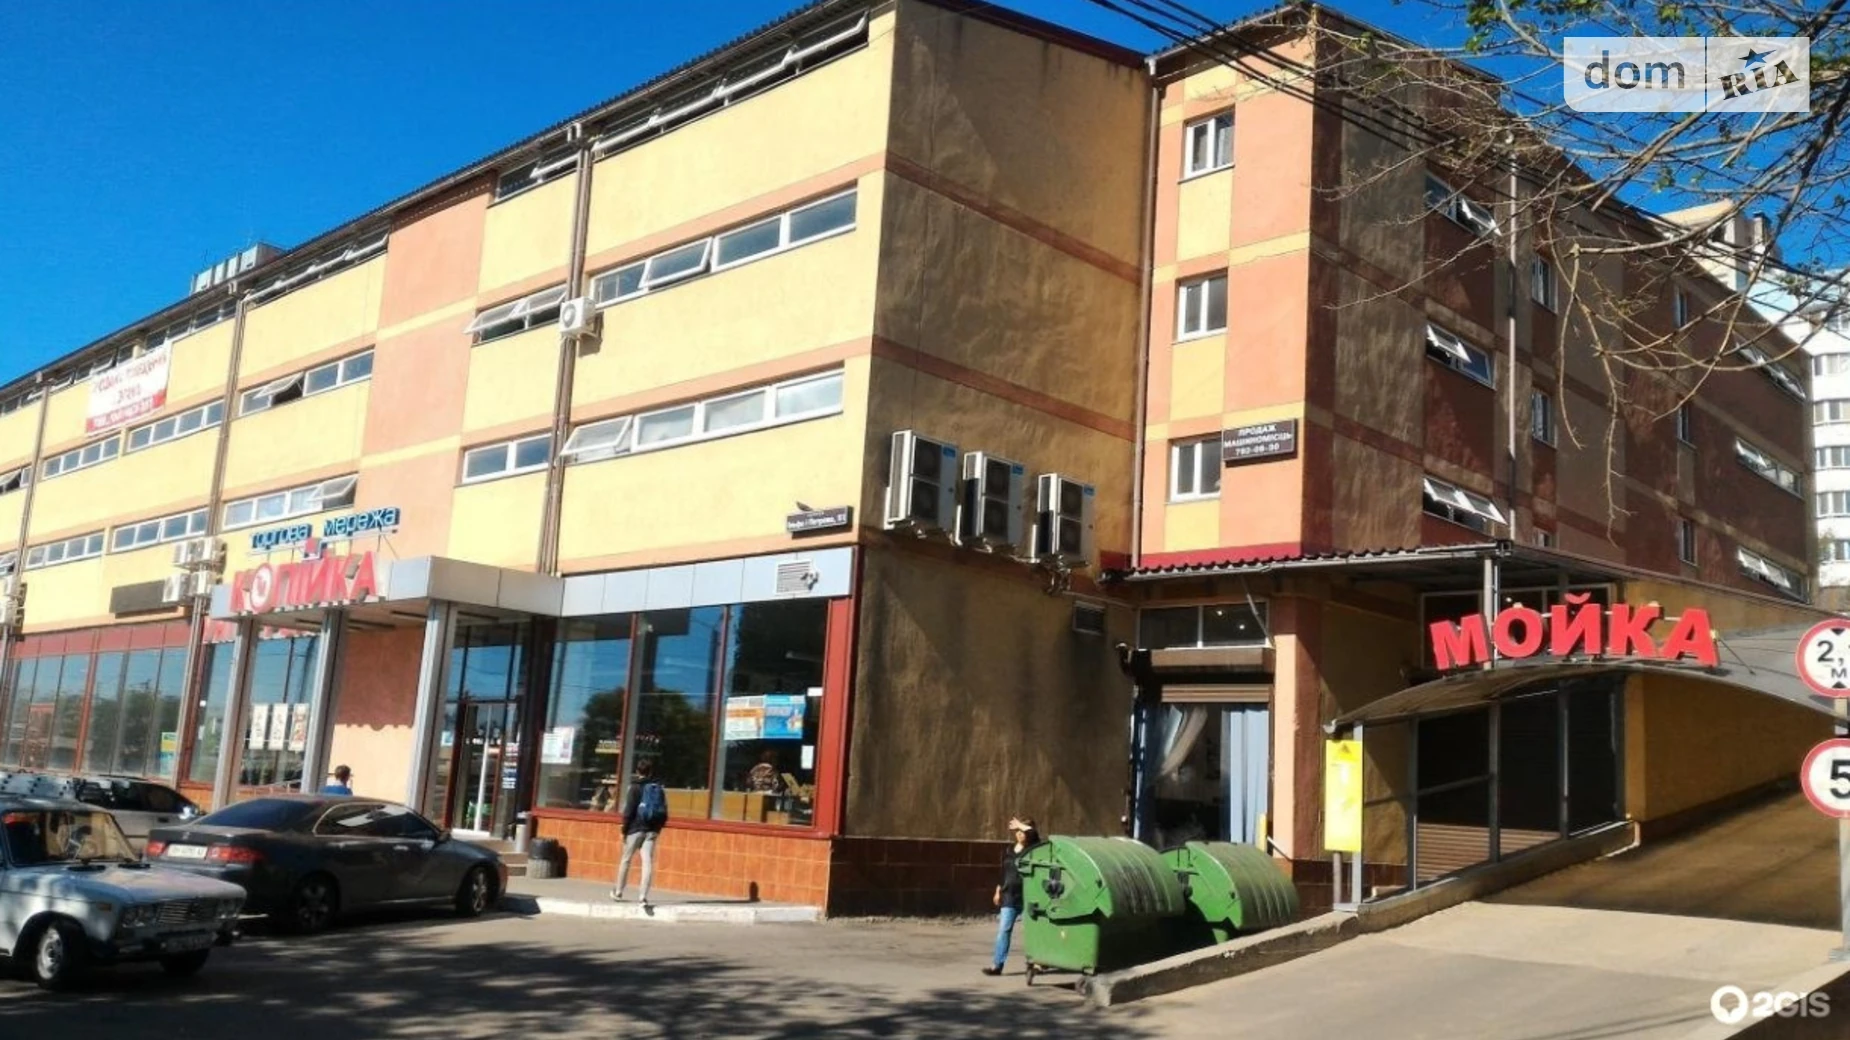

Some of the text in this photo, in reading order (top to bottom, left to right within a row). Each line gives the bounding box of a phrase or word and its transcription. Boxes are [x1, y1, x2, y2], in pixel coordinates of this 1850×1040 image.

[1238, 424, 1277, 437] ПРОДАЖ
[252, 507, 401, 550] торгова мережа
[1429, 592, 1719, 671] МОЙКА
[1816, 640, 1850, 666] 2,
